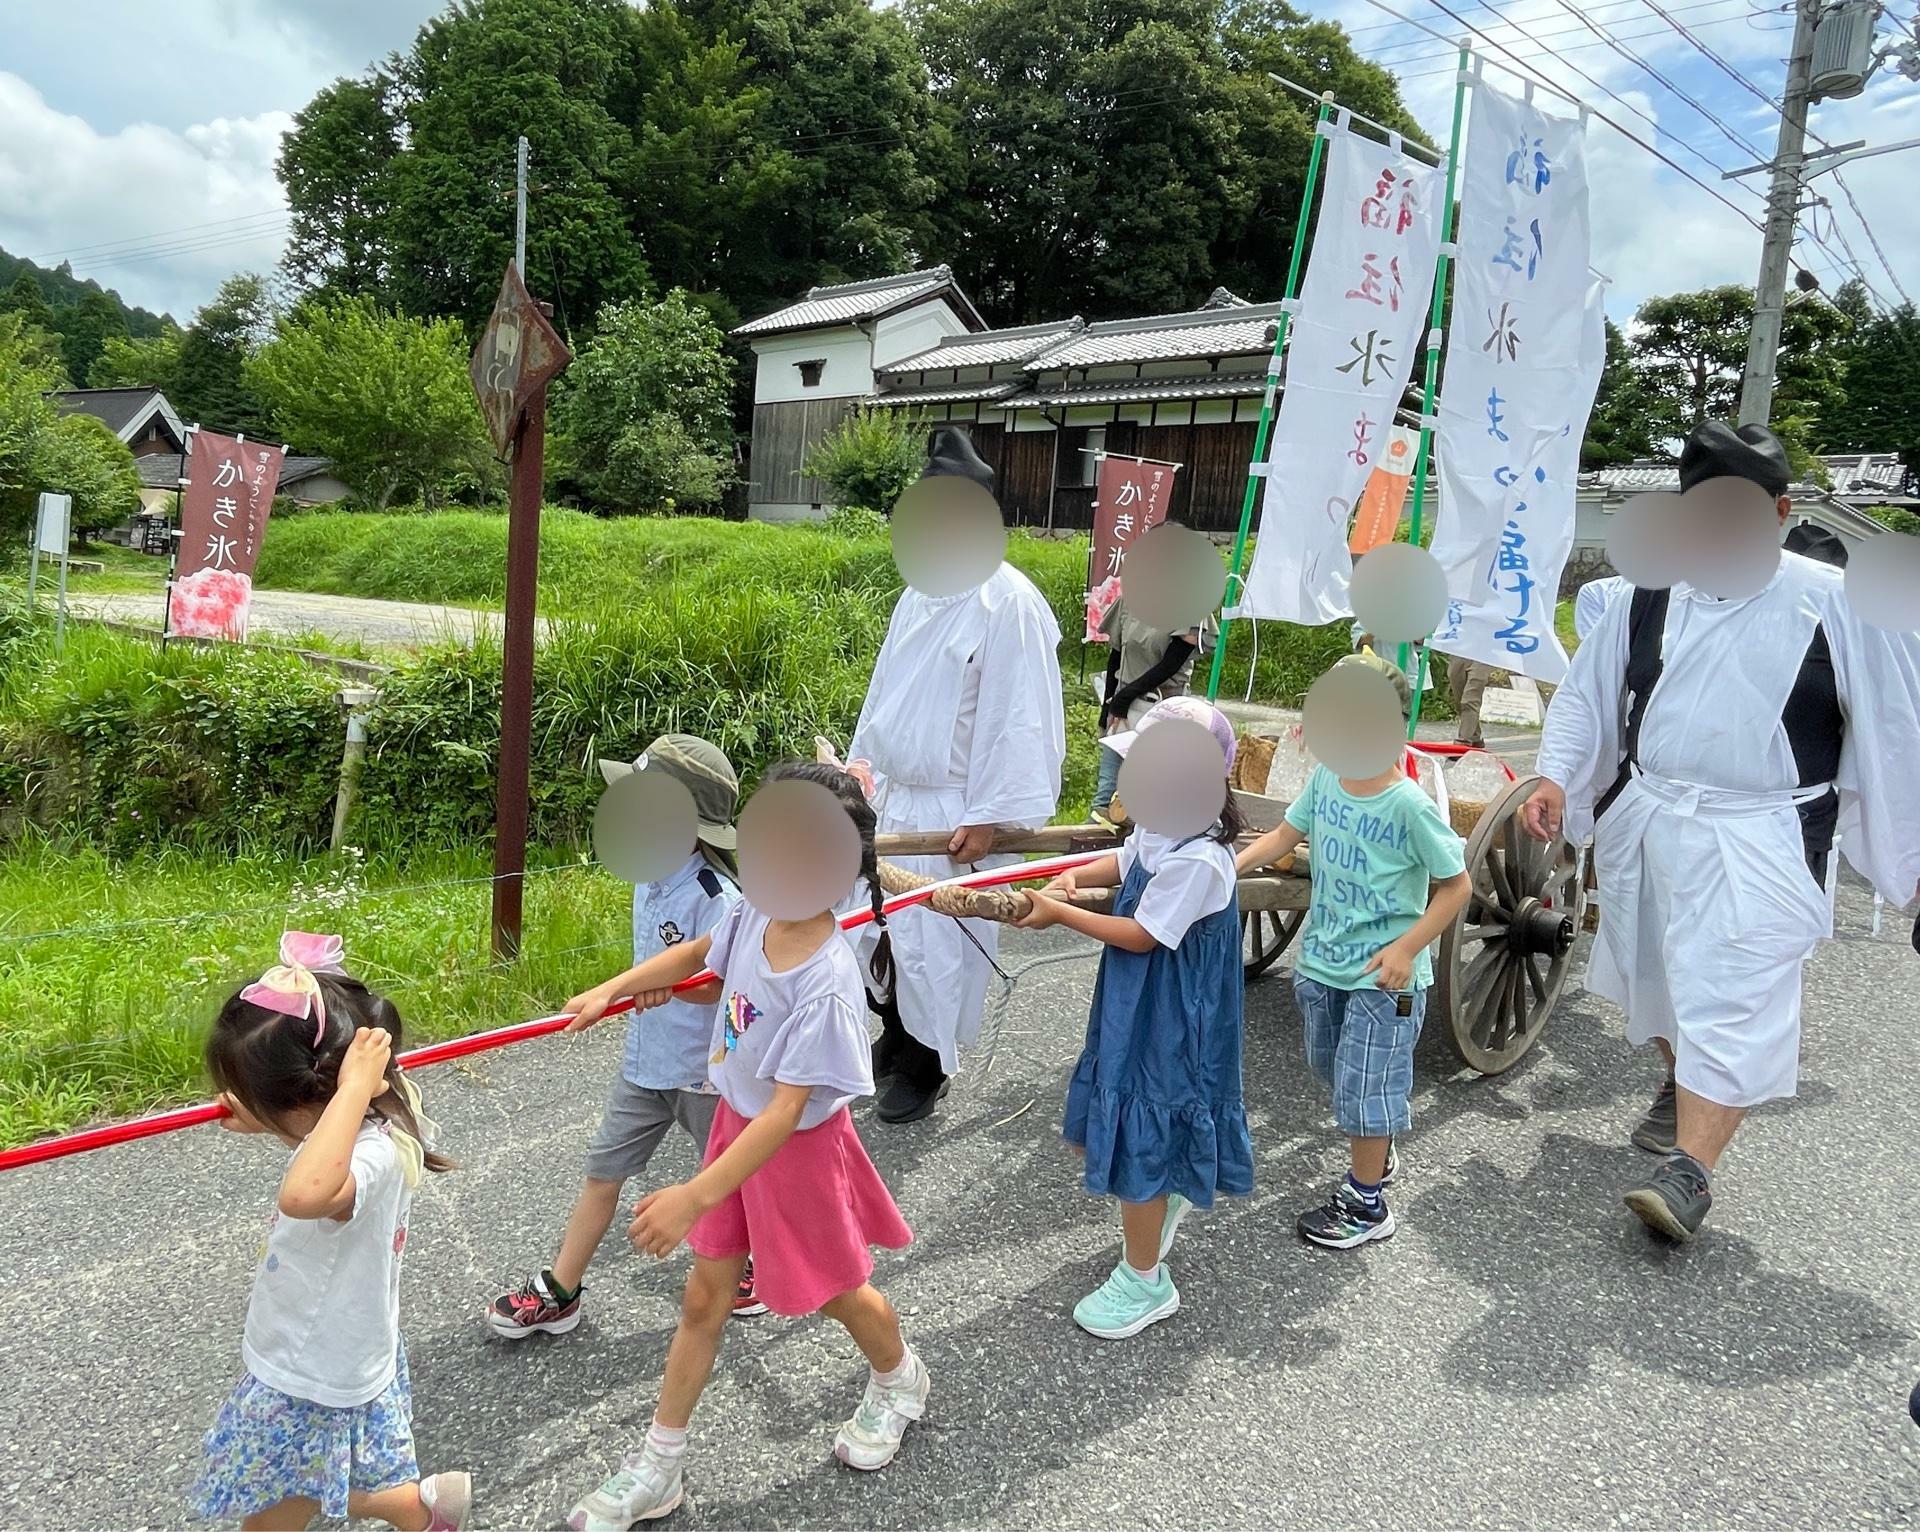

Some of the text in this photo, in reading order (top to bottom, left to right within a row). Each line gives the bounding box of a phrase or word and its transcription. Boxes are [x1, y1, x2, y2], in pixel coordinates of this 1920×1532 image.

[203, 459, 243, 569] かき氷
[1319, 832, 1368, 875] YOUR
[1333, 878, 1401, 914] STYLE
